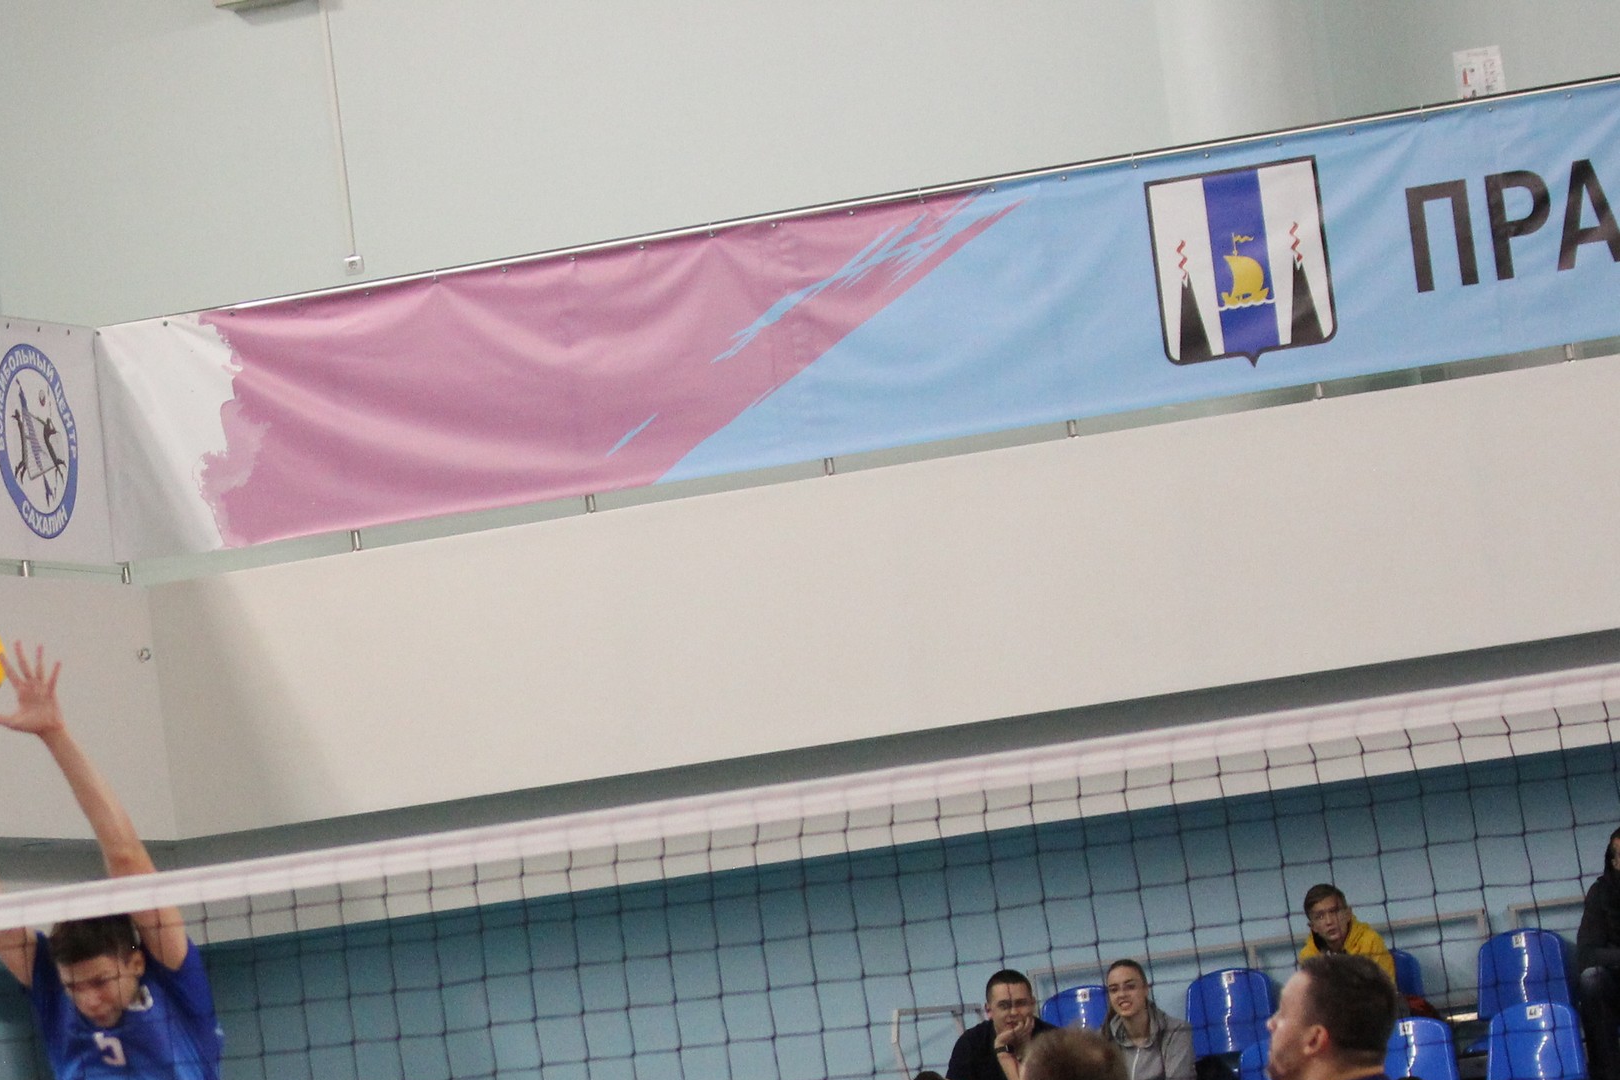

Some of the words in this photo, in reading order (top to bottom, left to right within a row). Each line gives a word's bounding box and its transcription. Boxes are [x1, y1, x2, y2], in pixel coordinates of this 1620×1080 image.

[1405, 158, 1620, 293] ПРА
[55, 382, 77, 459] ЦЕНТР
[22, 500, 67, 535] САХАЛИН
[93, 1031, 126, 1067] 5
